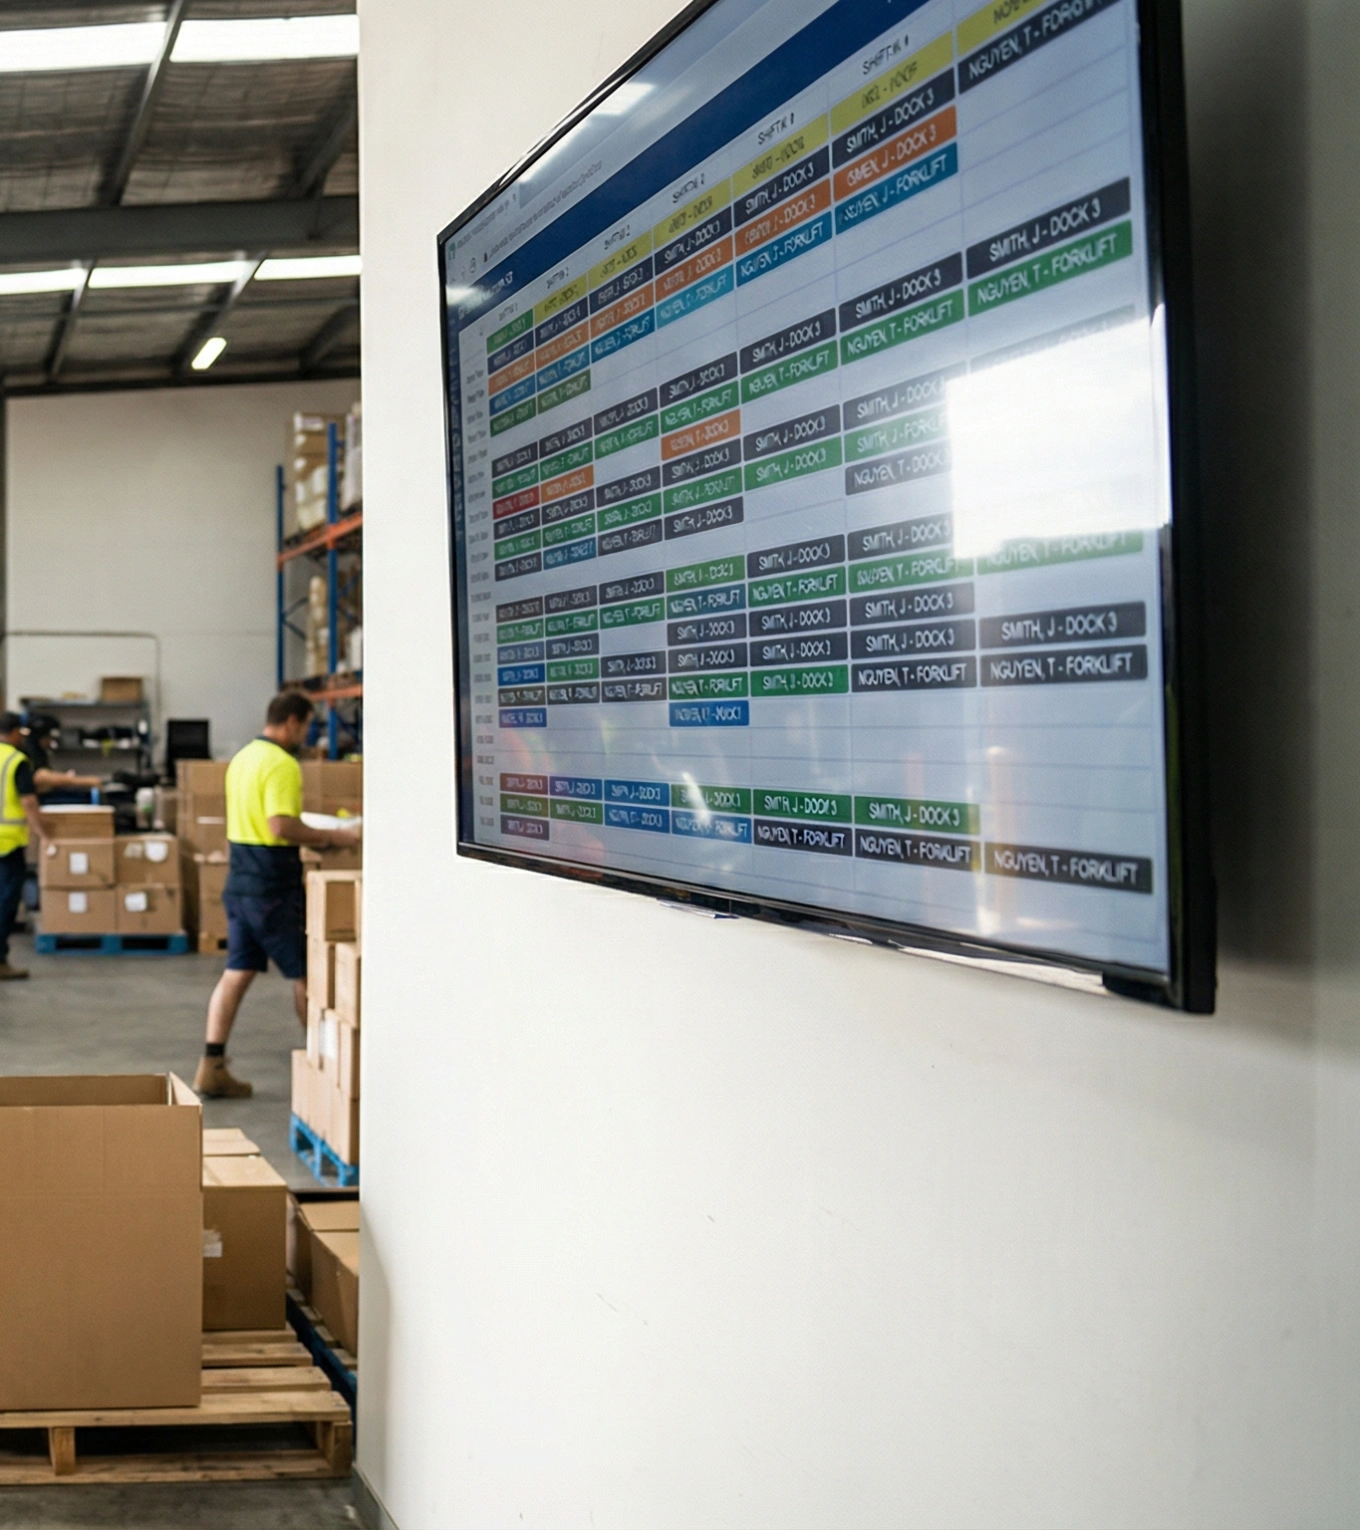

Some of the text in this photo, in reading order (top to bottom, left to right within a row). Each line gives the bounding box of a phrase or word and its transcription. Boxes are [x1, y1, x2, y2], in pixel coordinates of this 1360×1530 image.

[1024, 26, 1031, 46] T
[880, 116, 886, 133] J
[882, 150, 888, 168] J
[990, 229, 1031, 262] SMITH,
[1032, 223, 1039, 244] J
[1049, 202, 1089, 236] DOCK
[977, 270, 1031, 305] NGUYEN,
[1032, 264, 1041, 283] T
[1051, 233, 1117, 277] FORKLIFT
[888, 288, 895, 305] J
[889, 322, 897, 340] T
[900, 597, 906, 615] J
[1001, 618, 1044, 641] SMITH,
[1047, 616, 1055, 637] J
[1065, 612, 1107, 636] DOCK
[1108, 611, 1118, 633] 3
[901, 632, 907, 649] J
[902, 666, 909, 684] T
[990, 658, 1046, 681] NGUYEN,
[1047, 657, 1056, 678] T
[1066, 652, 1133, 676] FORKLIFT
[904, 805, 911, 822] J
[905, 840, 912, 857] T
[994, 850, 1050, 877] NGUYEN,
[1050, 855, 1060, 875] T
[1069, 857, 1138, 885] FORKLIFT
